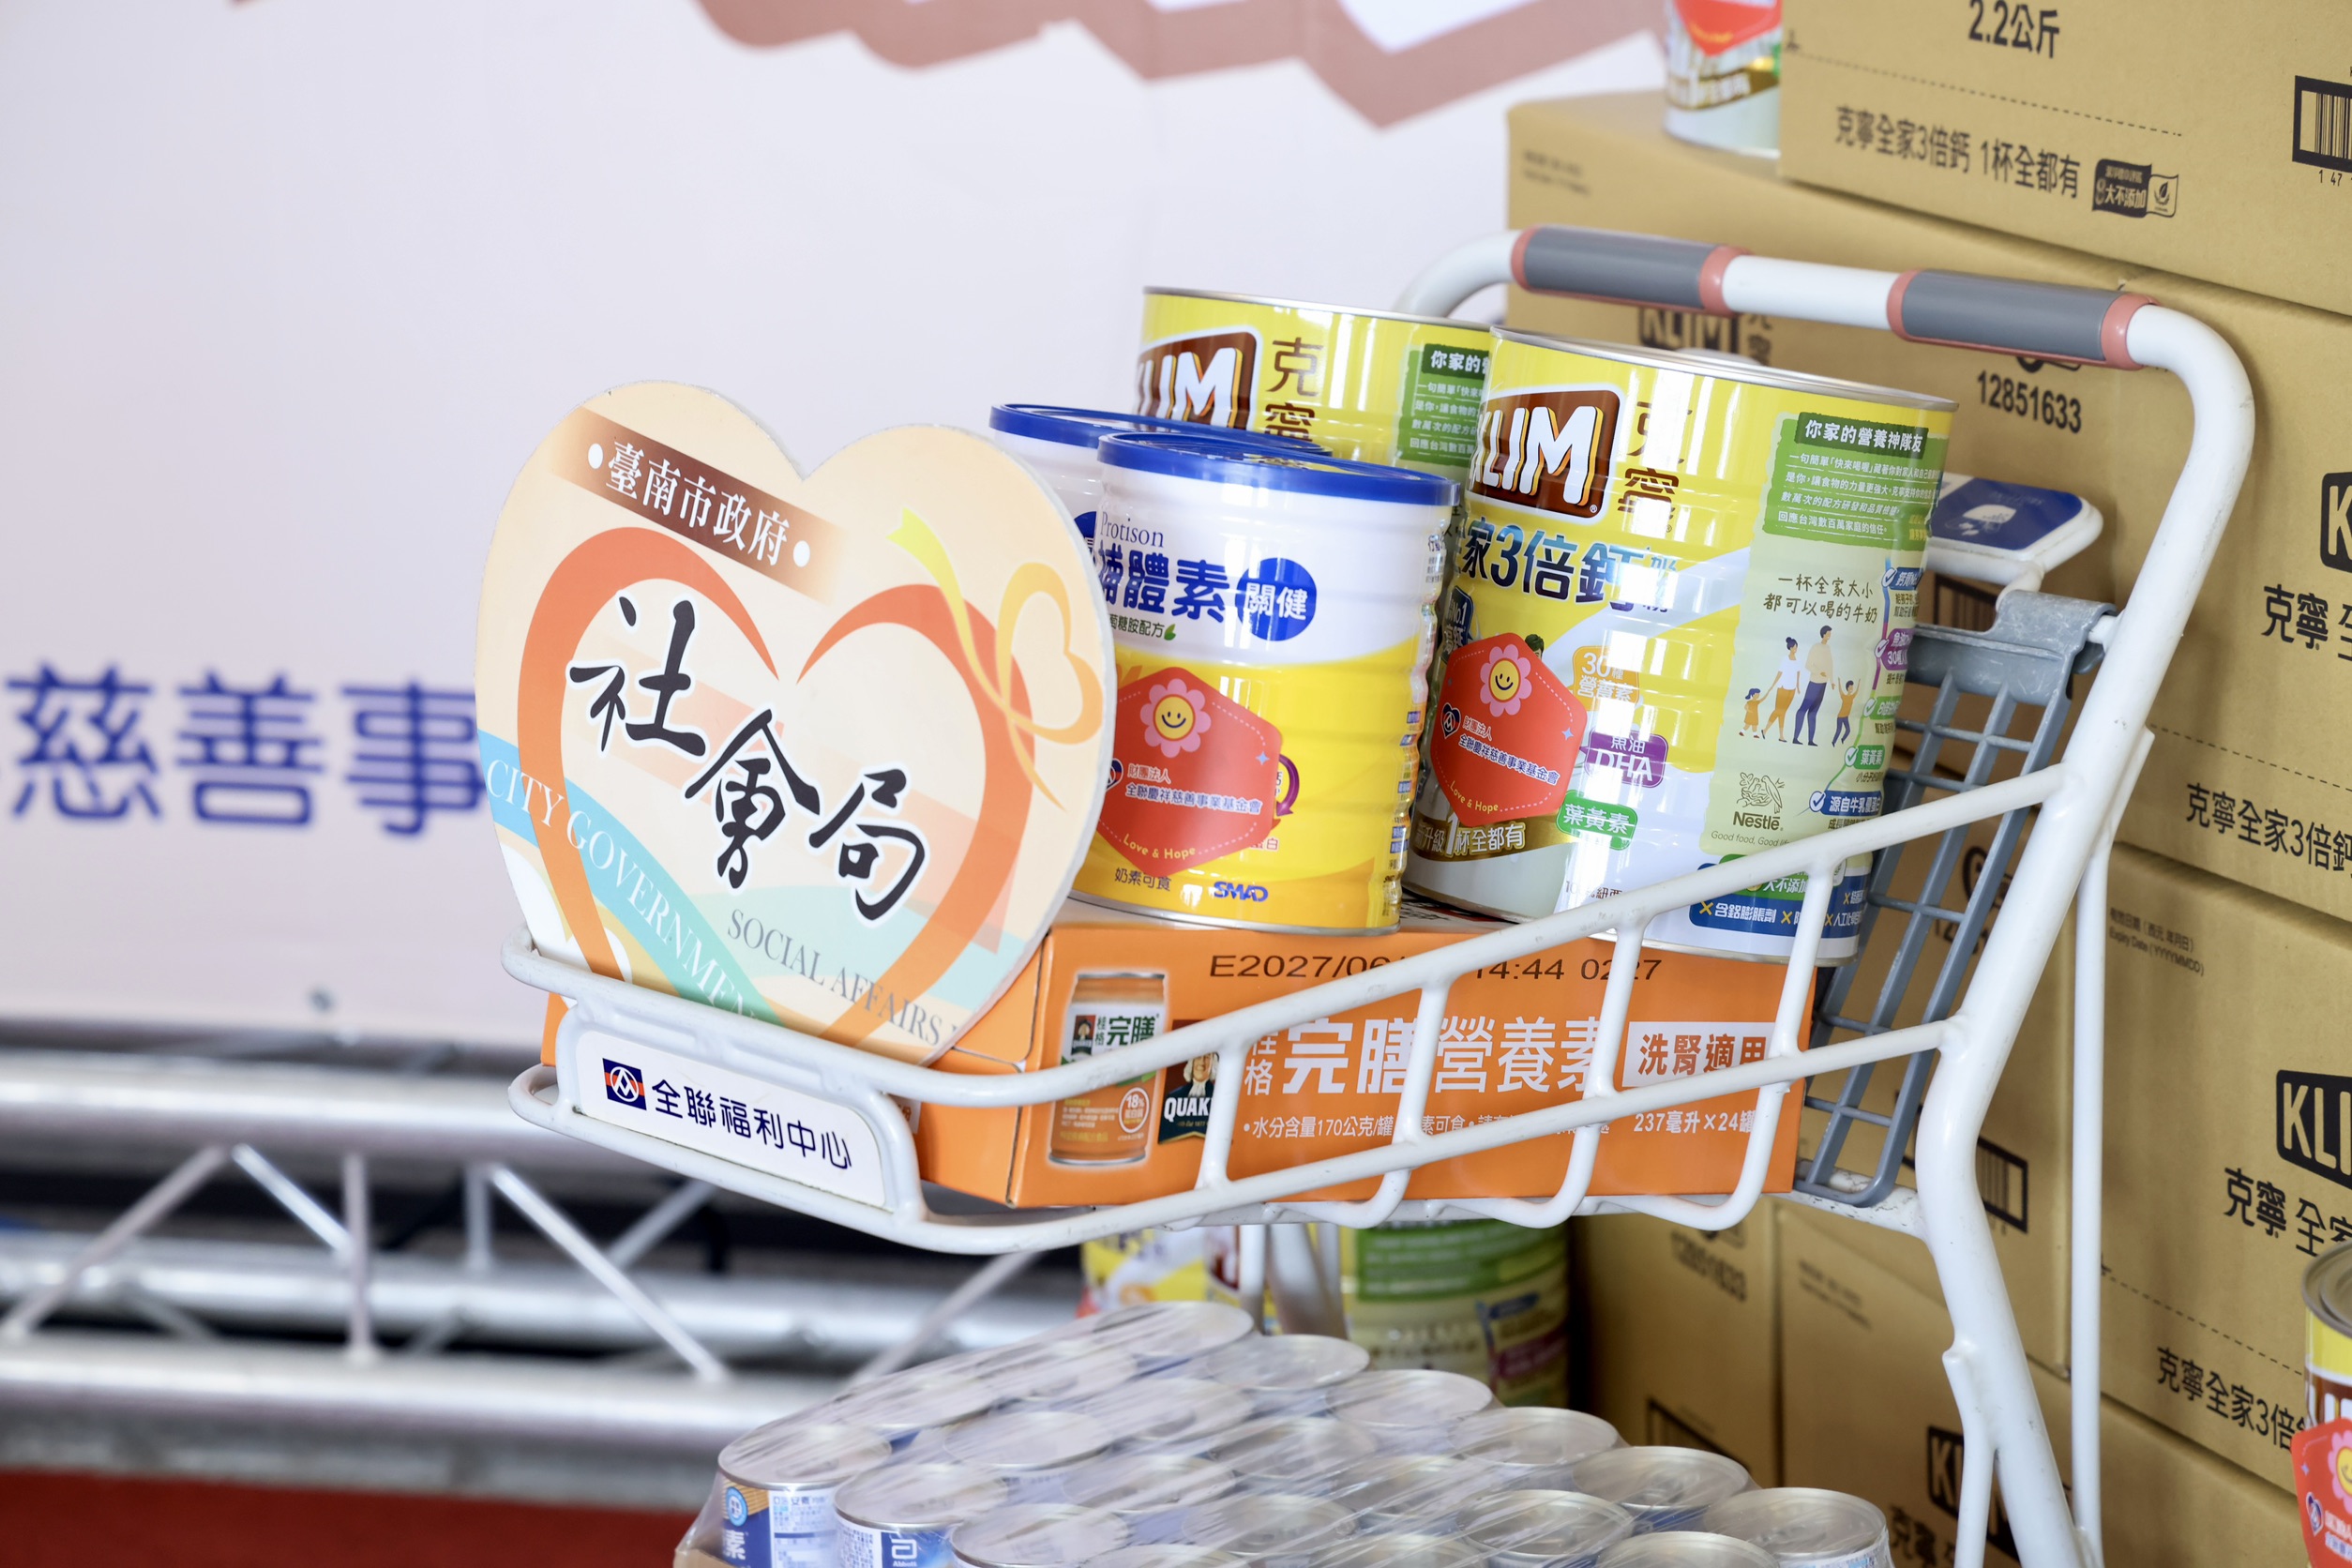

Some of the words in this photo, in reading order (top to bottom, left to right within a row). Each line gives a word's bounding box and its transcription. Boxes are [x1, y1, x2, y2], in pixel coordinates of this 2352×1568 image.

[1968, 0, 2060, 58] 2.2公斤
[1835, 105, 1972, 174] 克寧全家3倍鈣
[1981, 138, 2081, 200] 1杯全都有
[1978, 369, 2082, 434] 12851633
[1804, 418, 1923, 454] 你家的營養神隊友
[606, 441, 790, 566] 臺南市政府
[1101, 511, 1165, 548] Protison
[1245, 582, 1308, 622] 關健
[1778, 573, 1875, 599] 一杯全家大小
[1763, 592, 1878, 625] 都可以喝的牛奶
[2261, 583, 2329, 650] 克寧
[3, 661, 486, 839] 慈善事
[568, 596, 927, 922] 社會局
[1458, 733, 1560, 786] 全聯慶祥慈善事業基金會
[487, 759, 565, 827] CITY
[1127, 763, 1172, 785] 財團法人
[1125, 782, 1263, 816] 全聯慶祥慈善事業基金會
[1450, 780, 1466, 804] Love
[1474, 800, 1500, 814] Hope
[1562, 803, 1631, 836] 葉黃素
[1711, 830, 1735, 842] Good
[1123, 833, 1150, 856] Love
[1164, 848, 1197, 861] Hope
[1114, 867, 1172, 892] 奶素可食
[728, 908, 825, 987] SOCIAL
[830, 966, 942, 1048] AFFAIRS
[1580, 958, 1663, 981] 027
[651, 1078, 852, 1170] 全聯福利中心
[2157, 1346, 2304, 1451] 克寧全家3倍
